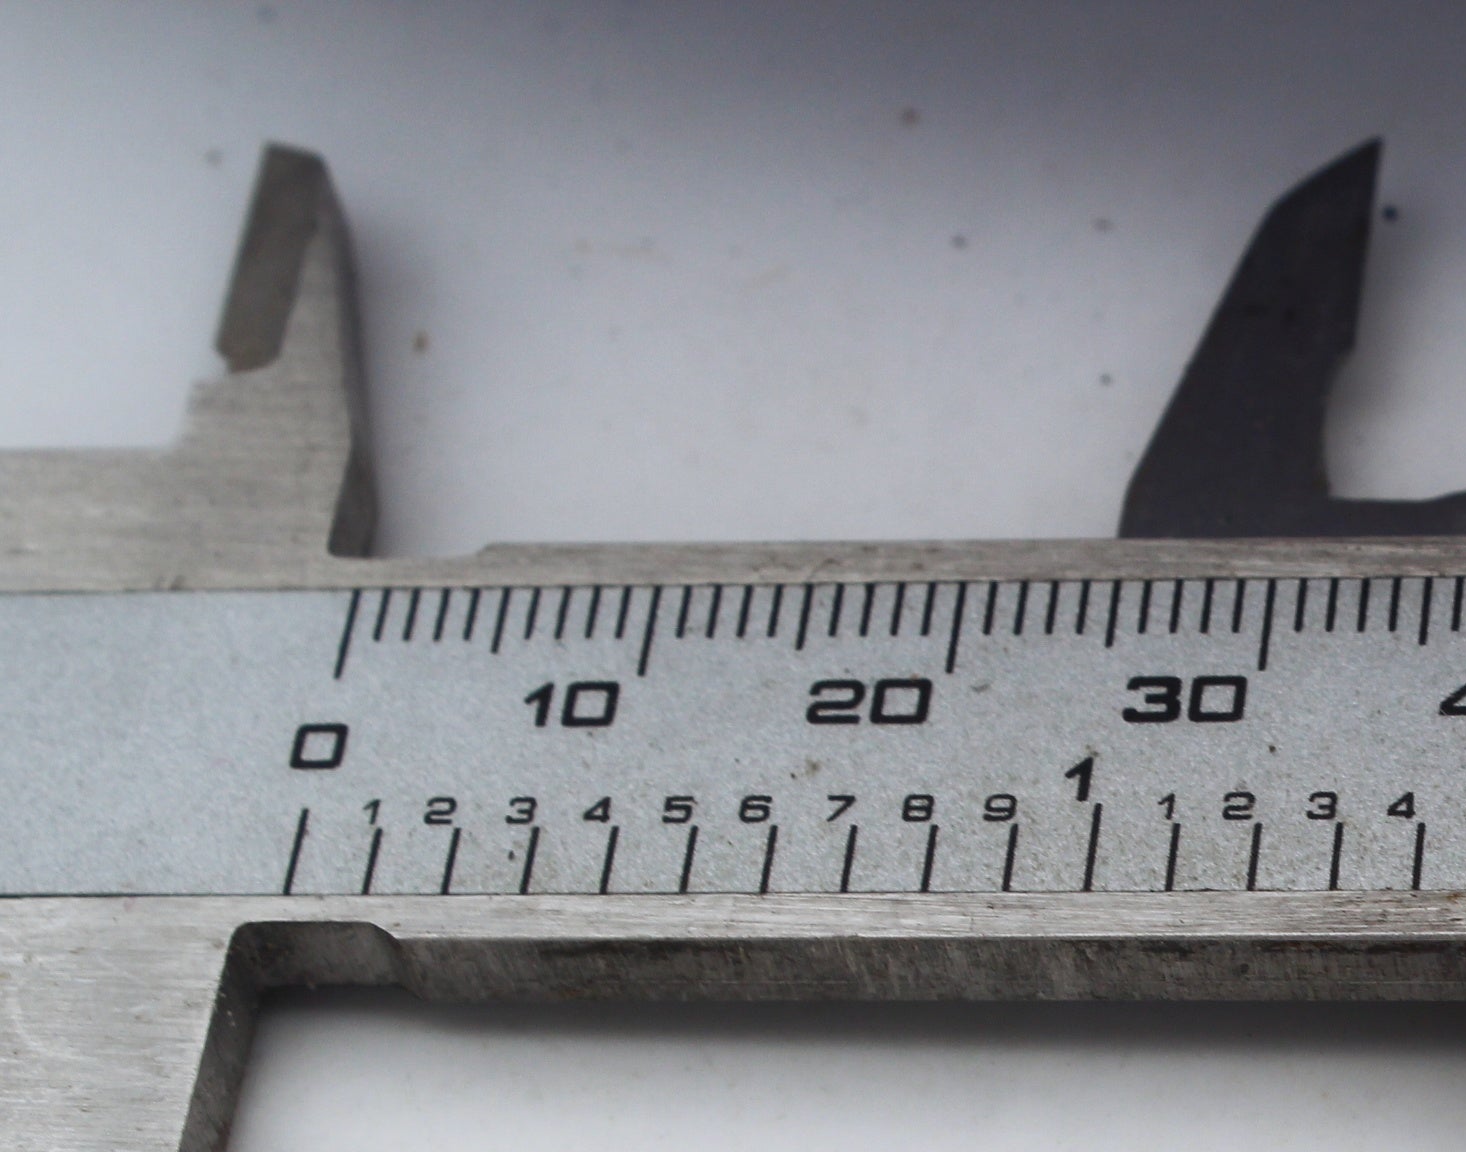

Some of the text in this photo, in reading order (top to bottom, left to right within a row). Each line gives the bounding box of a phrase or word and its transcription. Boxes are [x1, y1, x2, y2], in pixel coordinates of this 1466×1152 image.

[289, 723, 349, 771] 0
[524, 680, 621, 728] 10
[805, 676, 934, 726] 20
[1121, 674, 1248, 724] 30
[364, 799, 381, 826] 1
[423, 796, 458, 826] 2
[505, 796, 538, 826] 3
[582, 796, 612, 825] 4
[661, 795, 697, 825] 5
[738, 794, 773, 824] 6
[826, 794, 857, 824] 7
[901, 793, 935, 824] 8
[982, 793, 1018, 823] 9
[1064, 755, 1095, 803] 1
[1157, 792, 1176, 821] 1
[1221, 791, 1257, 821] 2
[1306, 790, 1339, 821] 3
[1386, 791, 1416, 820] 4
